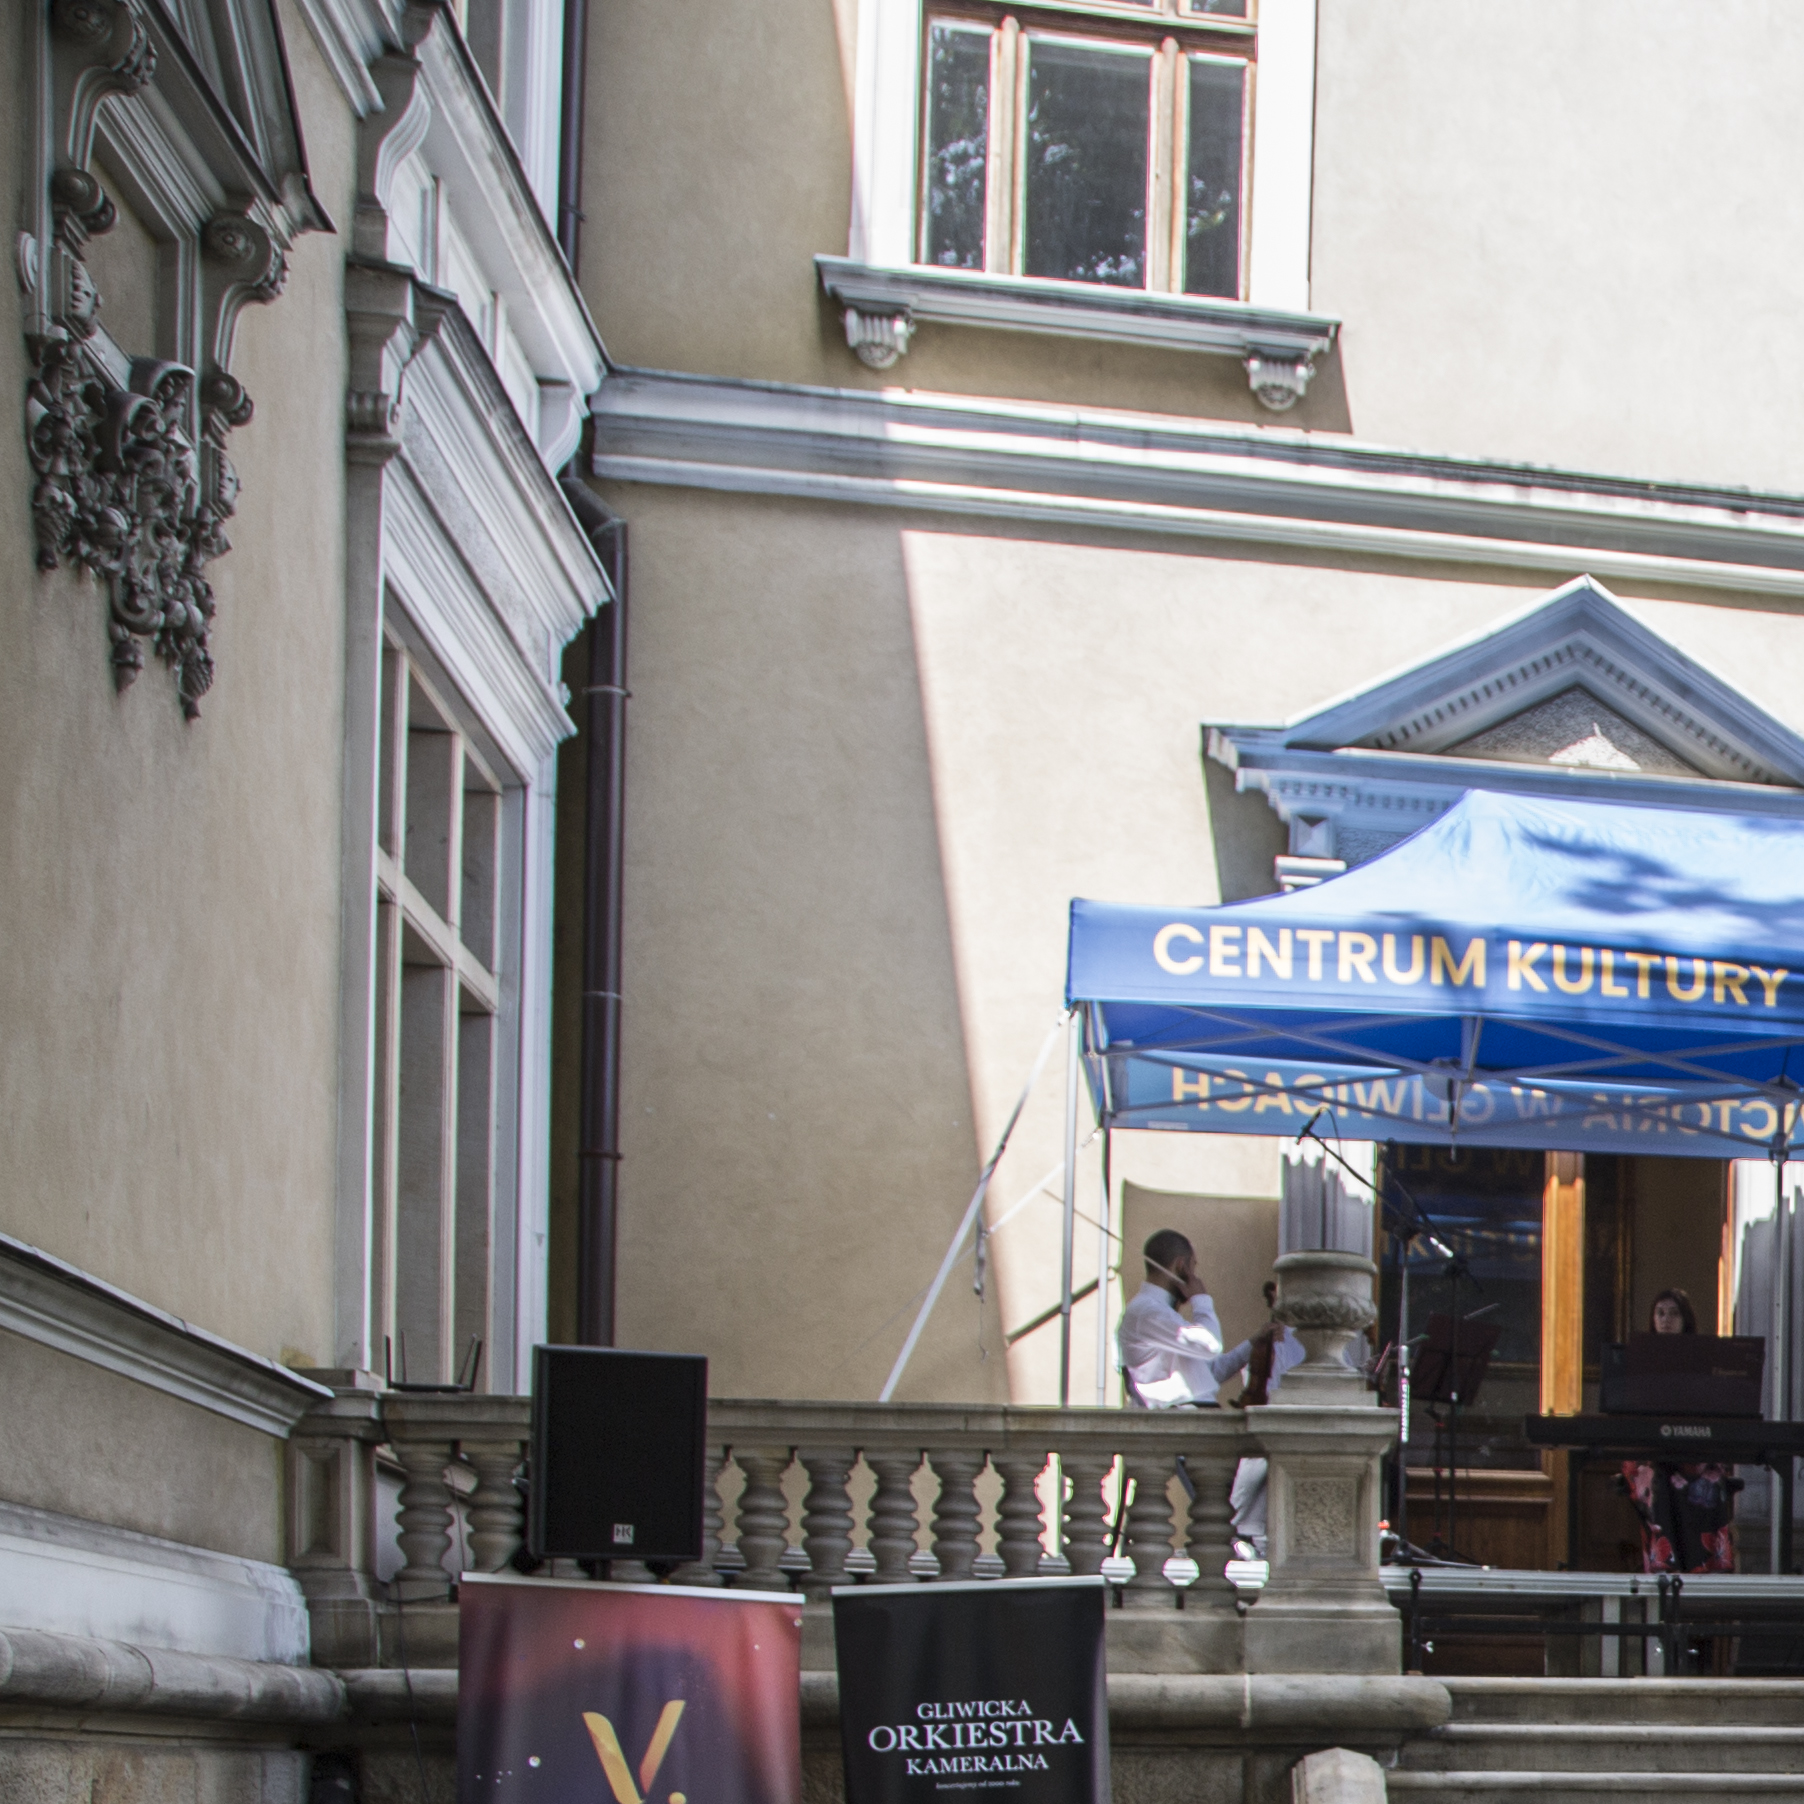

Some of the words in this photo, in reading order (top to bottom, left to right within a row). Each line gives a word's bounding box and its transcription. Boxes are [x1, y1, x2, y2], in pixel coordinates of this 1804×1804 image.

[1153, 922, 1487, 988] CENTRUM
[1507, 939, 1789, 1008] KULTURY
[1671, 1425, 1712, 1437] YAMAHA
[917, 1700, 1033, 1721] GLIWICKA
[868, 1718, 1085, 1752] ORKIESTRA
[906, 1753, 1049, 1775] KAMERALNA
